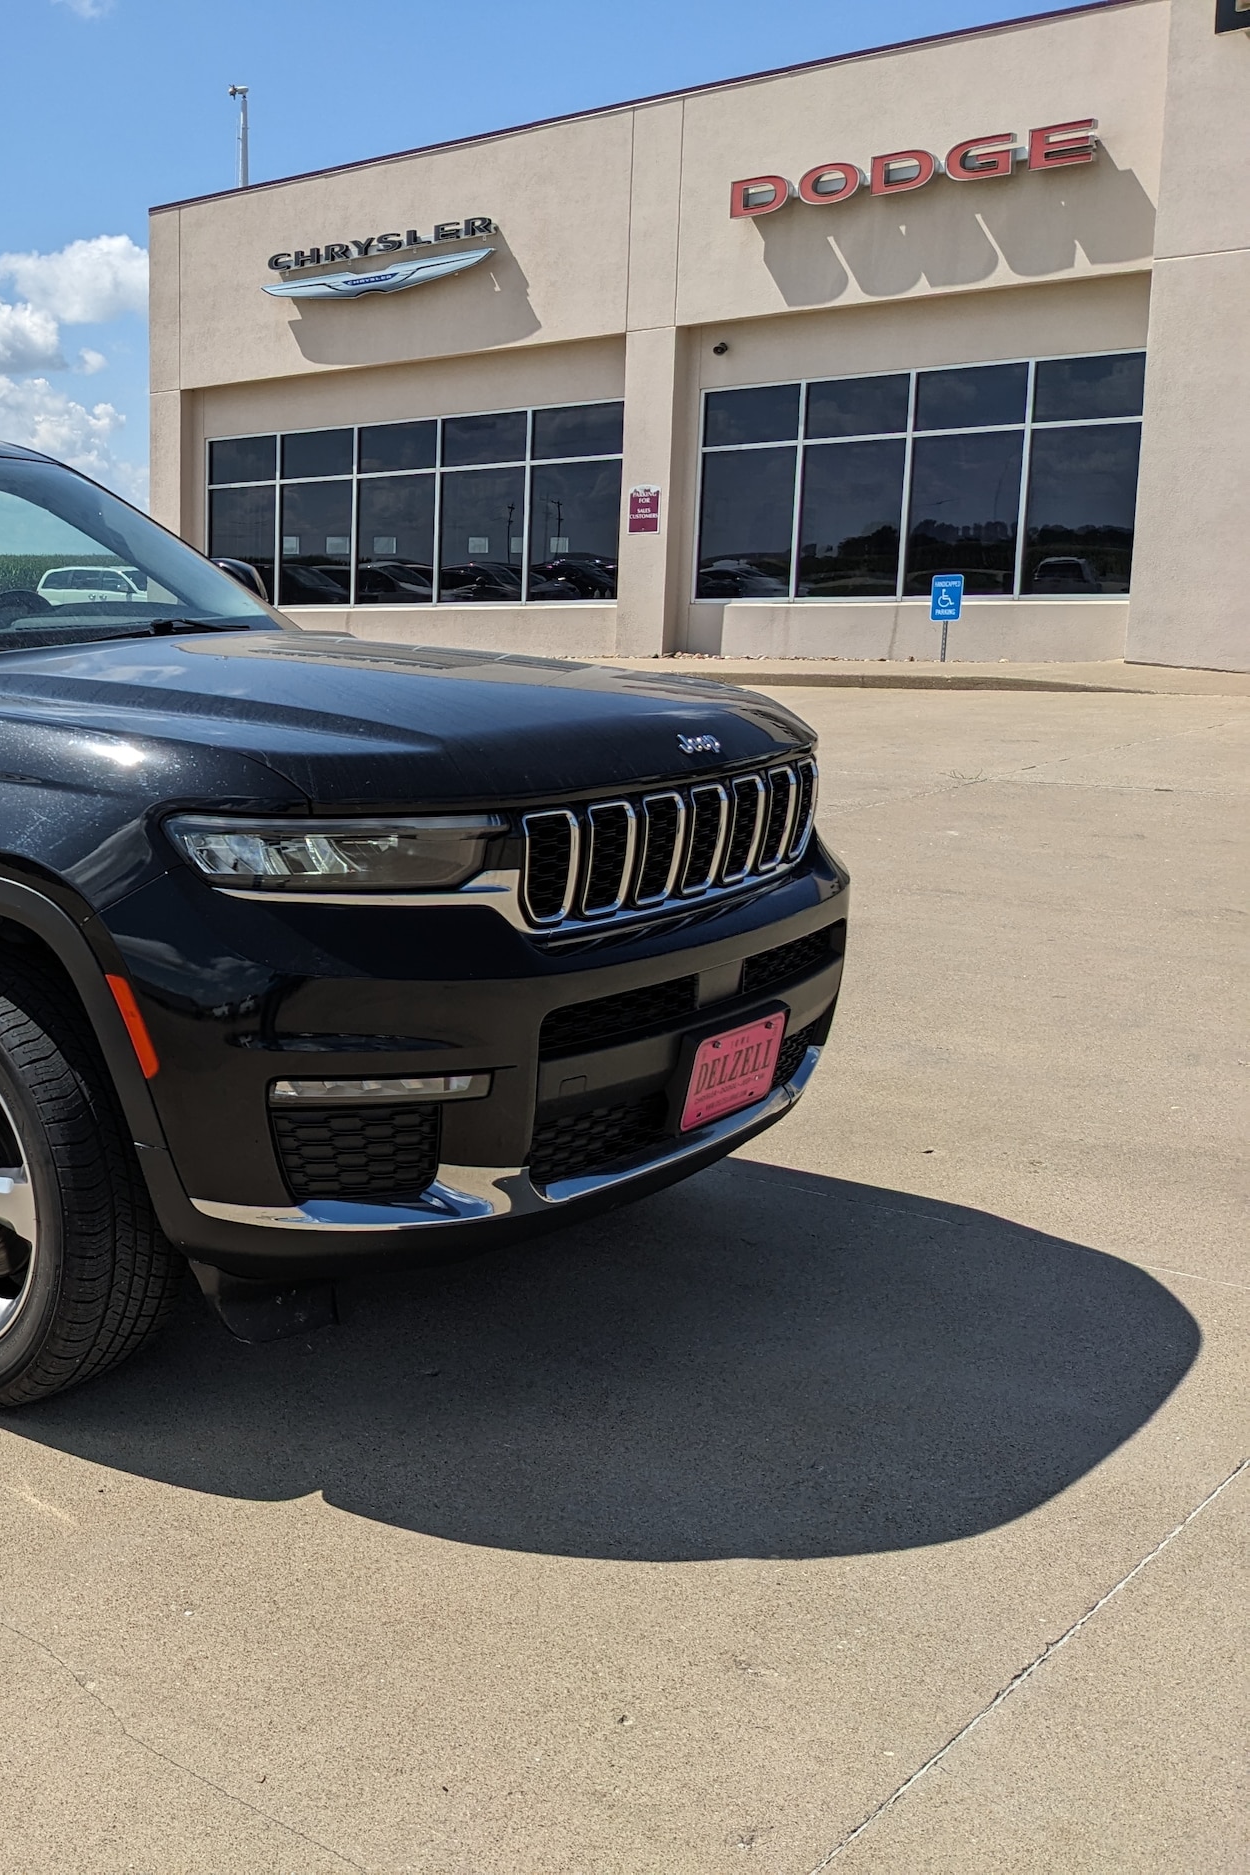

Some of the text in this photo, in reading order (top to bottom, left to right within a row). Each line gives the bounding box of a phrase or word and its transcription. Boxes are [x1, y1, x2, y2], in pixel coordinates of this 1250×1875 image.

[729, 118, 1098, 219] DODGE
[267, 216, 494, 272] CHRYSLER
[676, 733, 721, 754] Jeep
[693, 1038, 774, 1096] DELZELL
